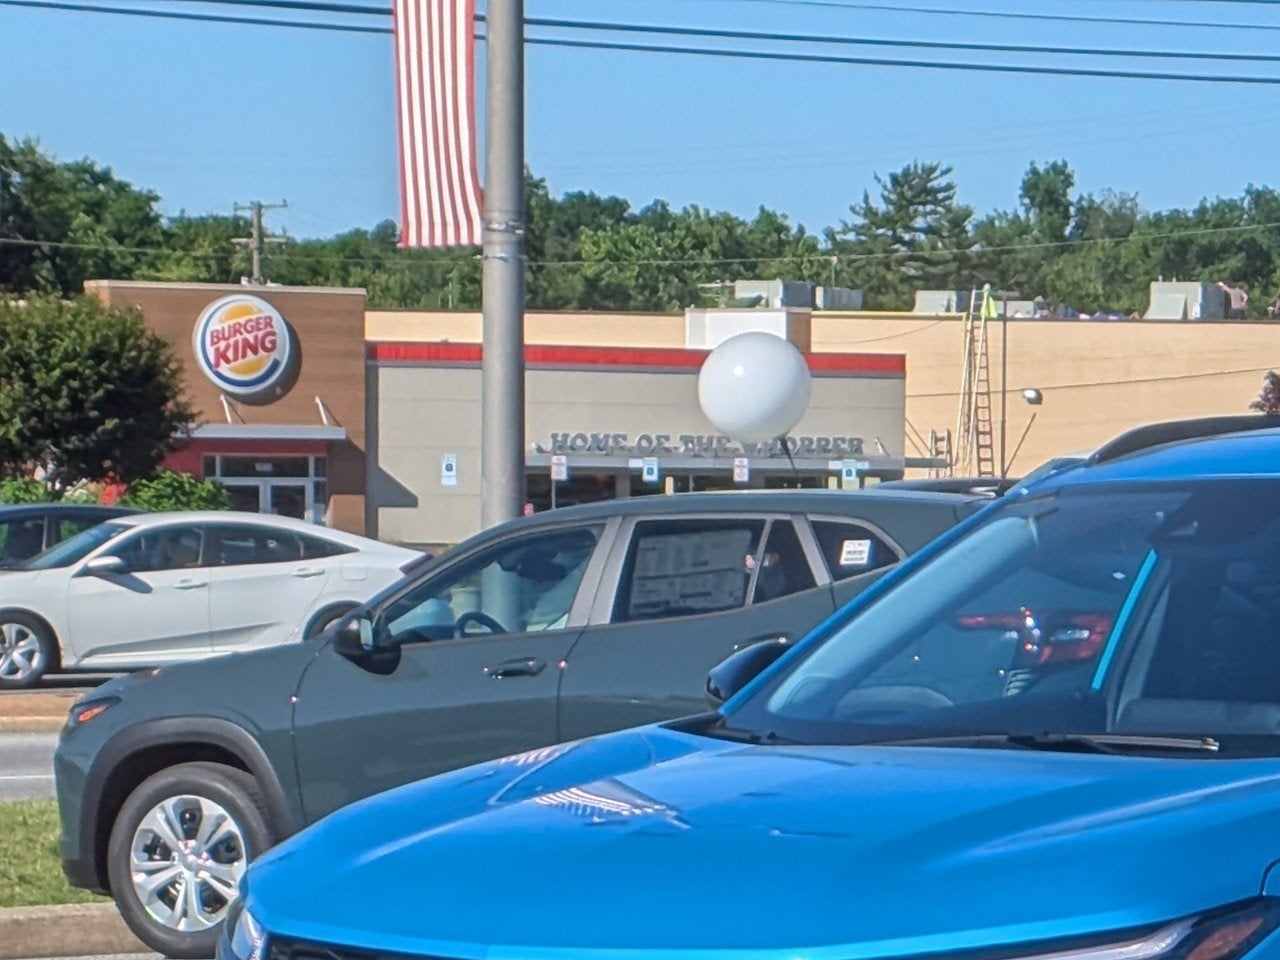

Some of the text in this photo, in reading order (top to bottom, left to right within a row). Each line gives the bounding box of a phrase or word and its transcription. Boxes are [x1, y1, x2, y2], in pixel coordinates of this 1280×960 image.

[210, 315, 274, 347] BURGER
[213, 330, 278, 369] KING
[550, 432, 628, 452] HOME
[635, 434, 671, 452] OF
